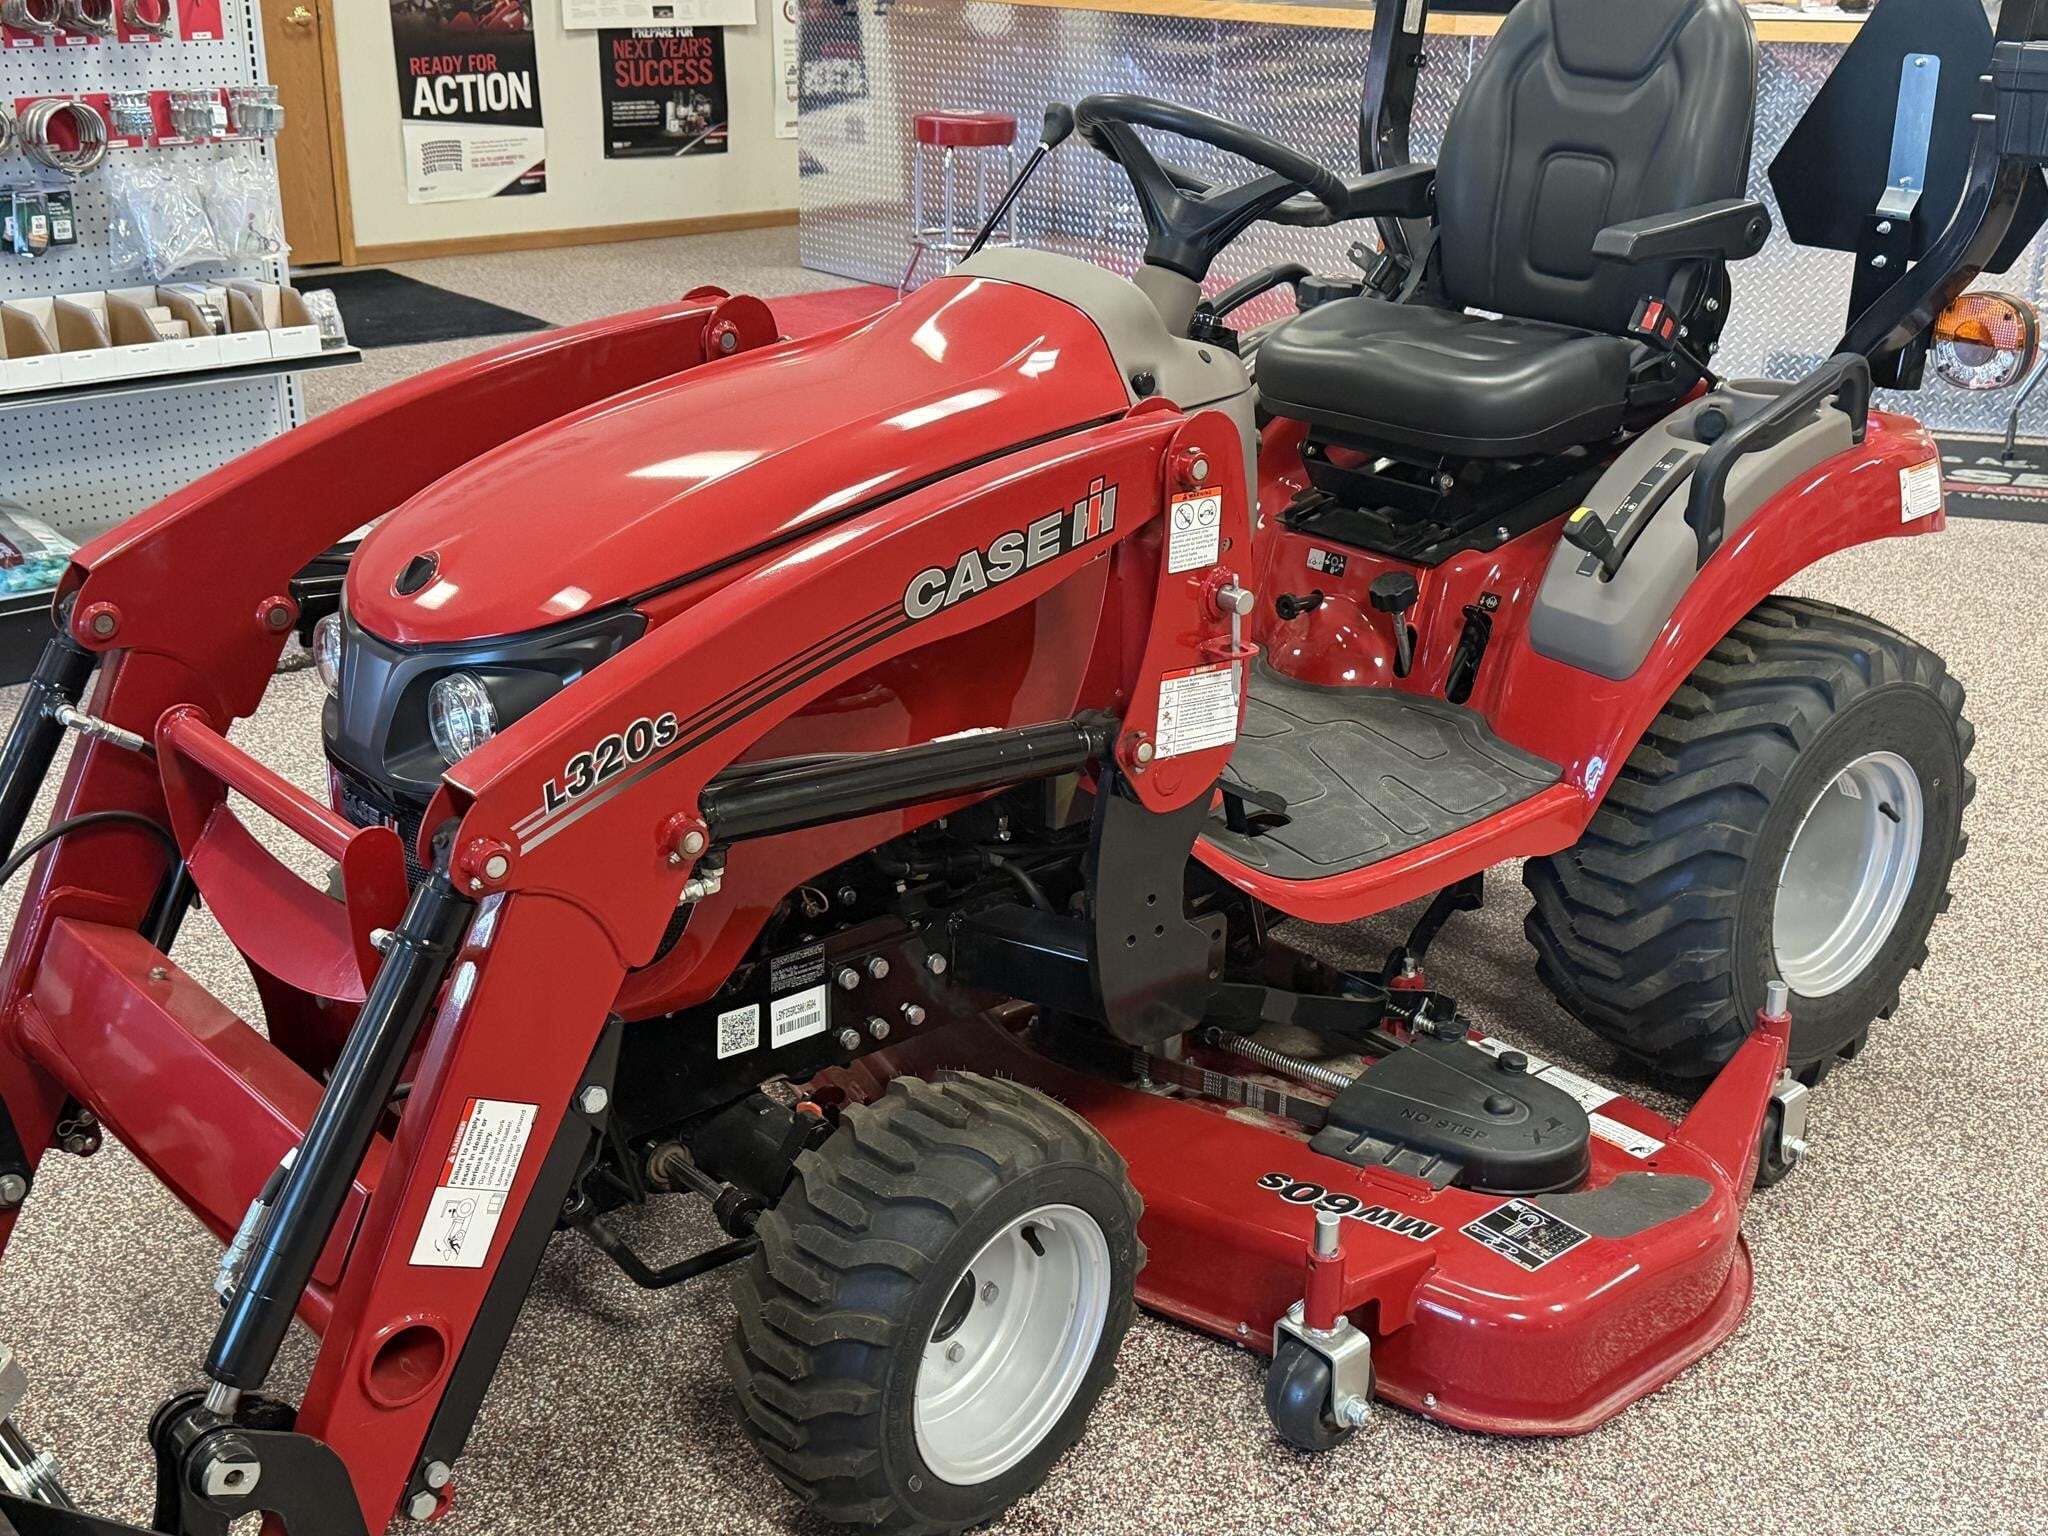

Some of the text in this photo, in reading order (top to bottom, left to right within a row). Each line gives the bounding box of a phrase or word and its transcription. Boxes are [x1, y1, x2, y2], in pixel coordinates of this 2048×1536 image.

[613, 38, 713, 59] NEXT YEAR'S
[632, 26, 694, 39] PREPARE FOR
[409, 53, 498, 76] READY FOR
[615, 58, 713, 88] SUCCESS
[413, 71, 532, 116] ACTION
[904, 511, 1063, 619] CASE
[451, 1121, 467, 1153] DANGER
[1400, 1107, 1489, 1140] NO STEP
[450, 1102, 485, 1185] Failure to comply will
[461, 1163, 472, 1185] result
[472, 1129, 484, 1151] death
[481, 1118, 487, 1127] or
[469, 1132, 493, 1186] serious injury.
